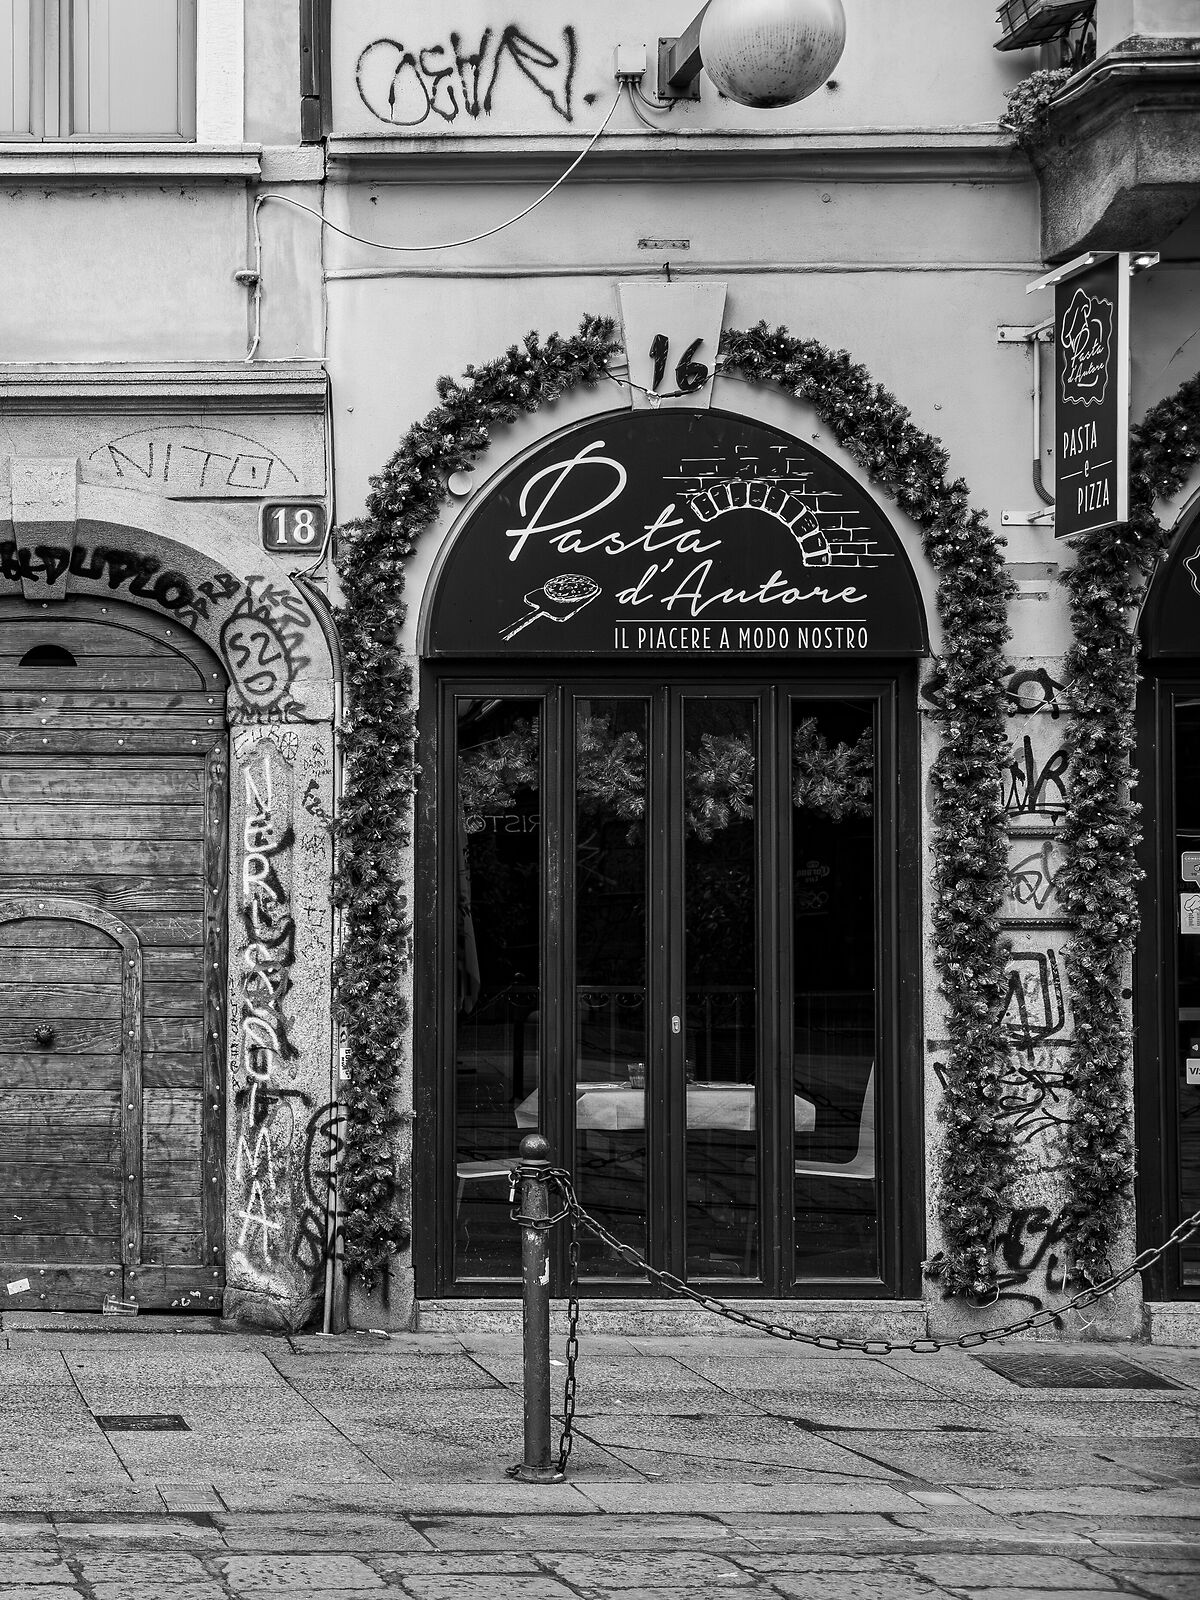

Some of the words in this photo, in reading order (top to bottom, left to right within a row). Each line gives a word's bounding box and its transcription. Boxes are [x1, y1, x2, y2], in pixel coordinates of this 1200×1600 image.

[651, 333, 709, 393] 16
[1063, 420, 1097, 459] PASTA
[1083, 459, 1090, 478] e
[505, 440, 722, 562] Pasta
[1077, 478, 1110, 515] PIZZA
[274, 508, 315, 545] 18
[615, 557, 867, 617] d'Autore
[614, 627, 630, 649] IL
[638, 627, 711, 649] PIACERE
[719, 627, 731, 649] A
[738, 627, 790, 649] MODO
[798, 627, 868, 649] NOSTRO
